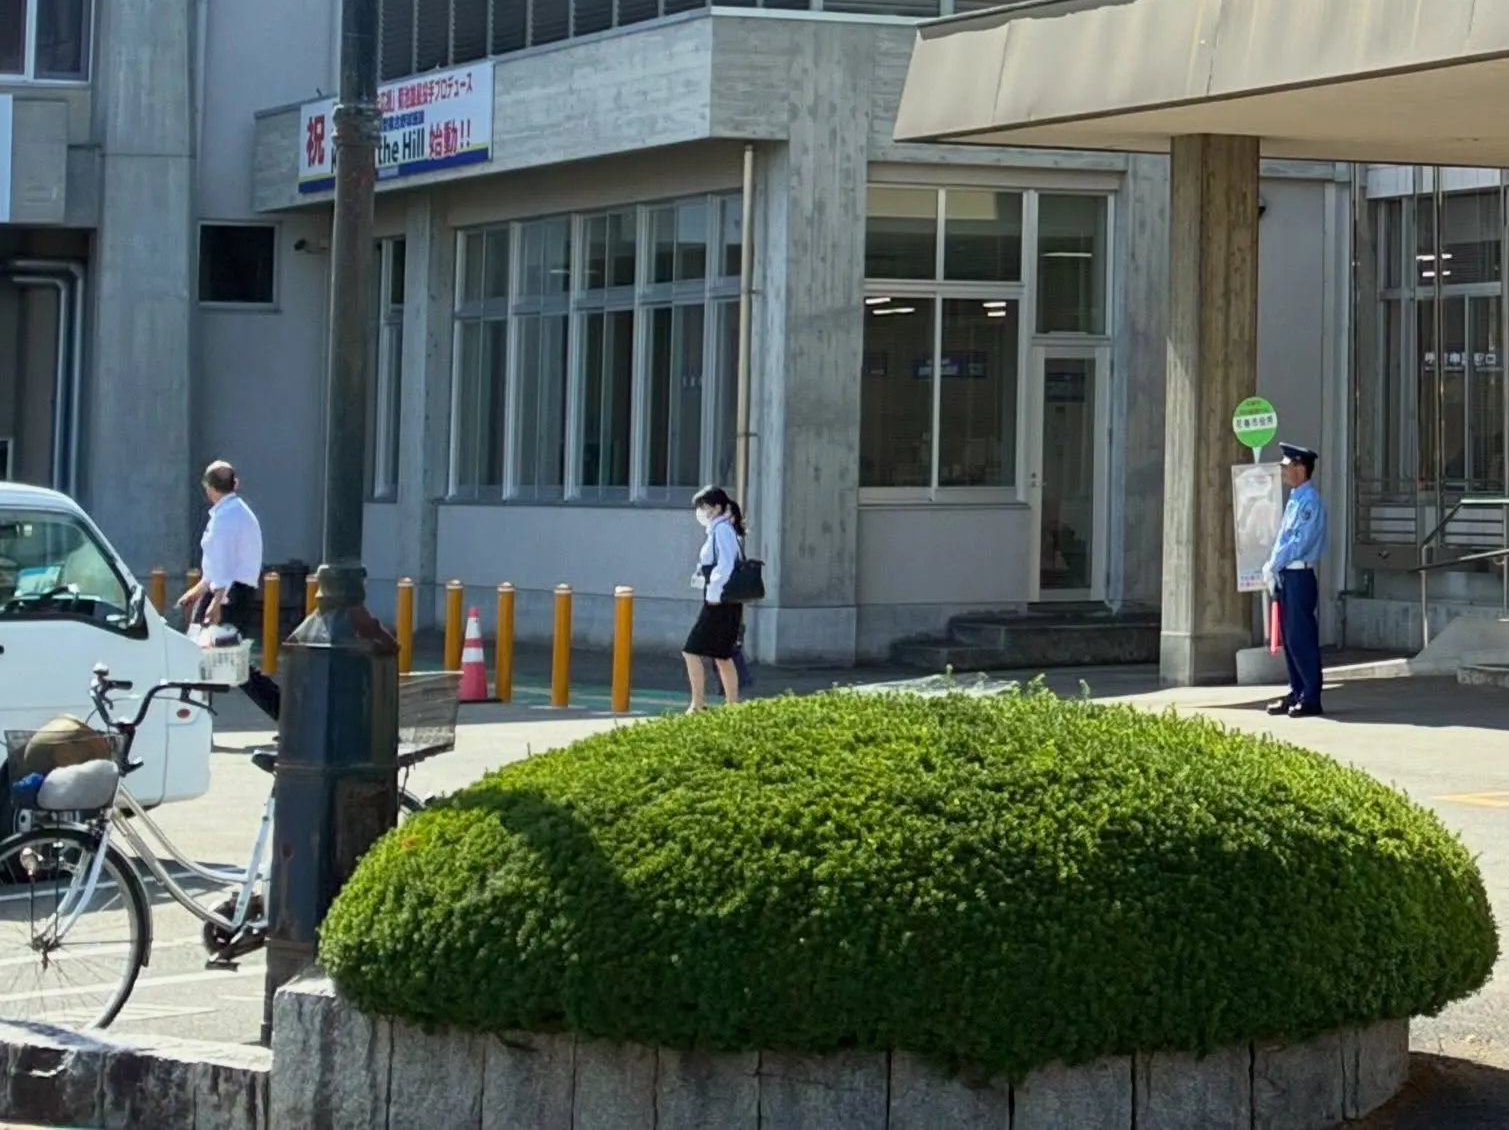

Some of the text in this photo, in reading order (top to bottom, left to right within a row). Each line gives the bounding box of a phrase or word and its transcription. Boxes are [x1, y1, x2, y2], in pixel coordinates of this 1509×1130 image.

[306, 114, 325, 167] 祝
[377, 133, 399, 164] the
[402, 126, 425, 160] Hill
